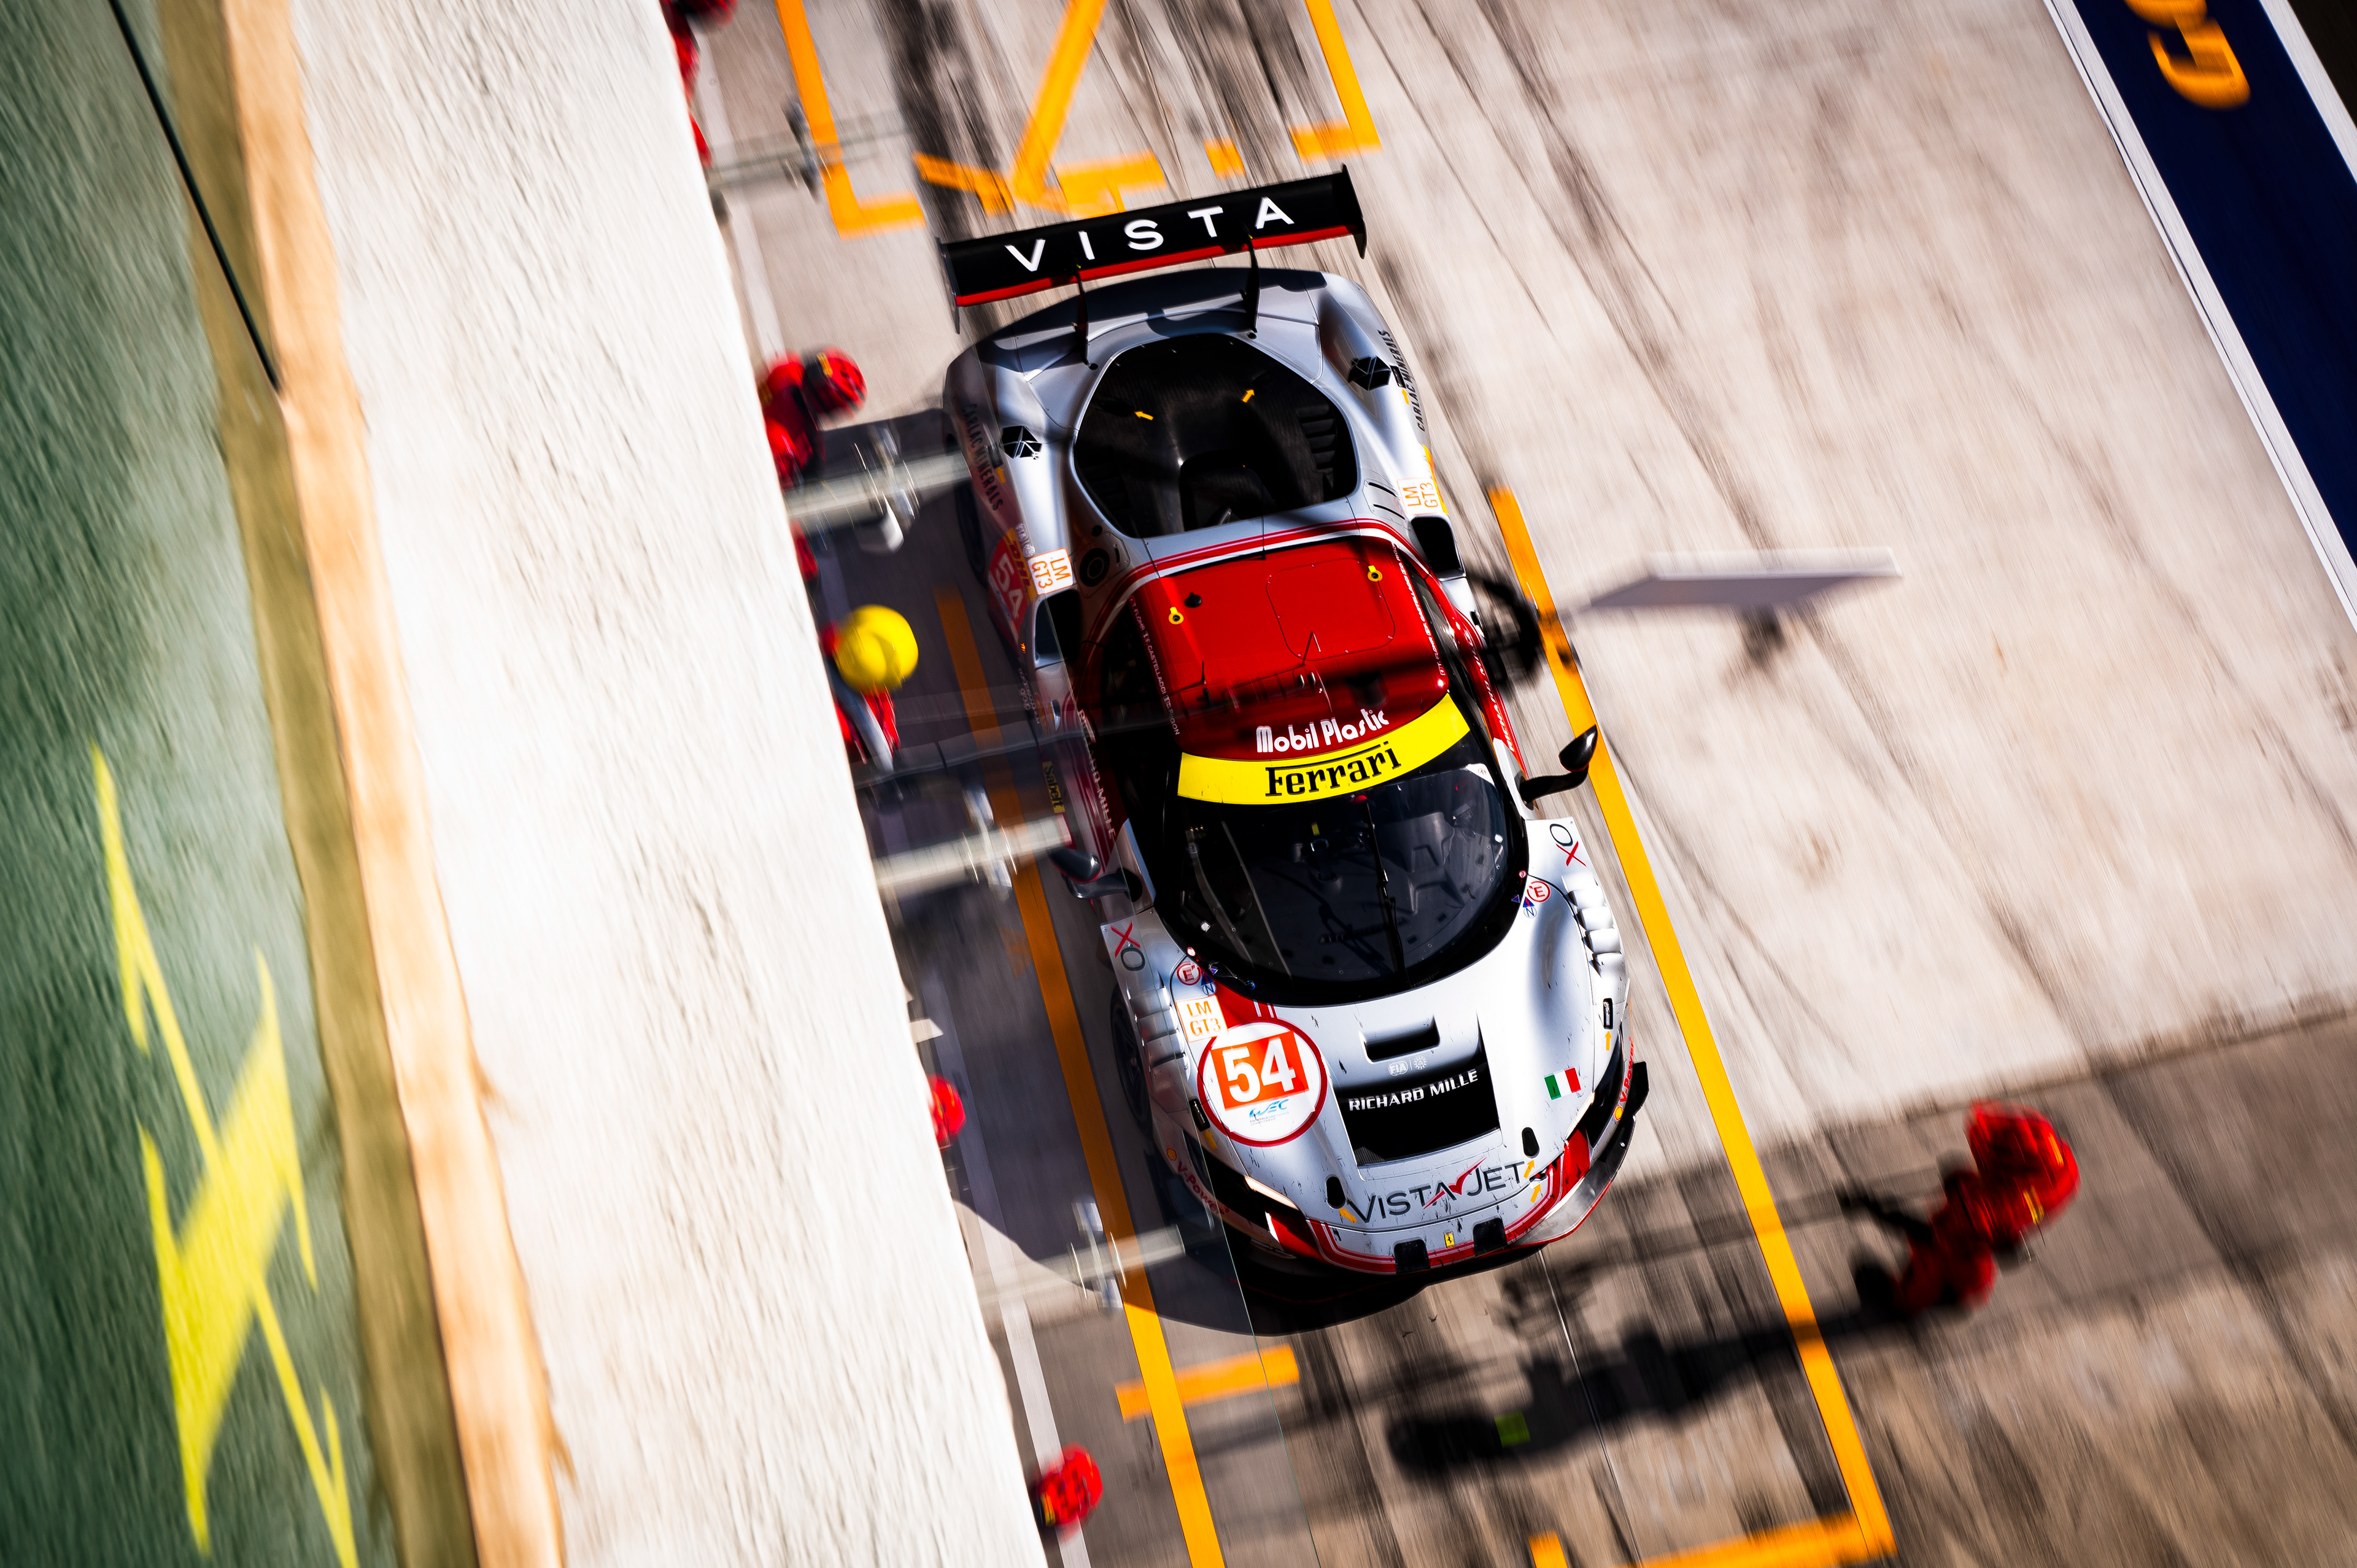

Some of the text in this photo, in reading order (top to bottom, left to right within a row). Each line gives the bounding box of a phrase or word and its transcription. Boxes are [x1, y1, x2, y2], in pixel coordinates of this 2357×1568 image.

[1005, 196, 1295, 271] VISTA
[1377, 330, 1426, 431] CARLAC MINERALS
[962, 403, 1004, 511] CARLAC MINERALS
[1403, 487, 1422, 506] LM
[1420, 482, 1439, 508] GT3
[996, 552, 1024, 619] 54
[1009, 540, 1031, 587] DHL
[1031, 560, 1054, 589] GT3
[1050, 557, 1072, 581] LM
[1256, 708, 1389, 753] Mobil Plastic
[1045, 765, 1064, 808] Sabelt
[1264, 741, 1401, 797] Ferrari
[1186, 1000, 1213, 1018] LM
[1189, 1017, 1222, 1037] GT3
[1221, 1036, 1298, 1103] 54
[1349, 1069, 1479, 1111] RICHARD MILLE
[1389, 1062, 1407, 1075] FIA
[1619, 1040, 1635, 1103] V-Power
[1347, 1160, 1525, 1223] VISTAJET
